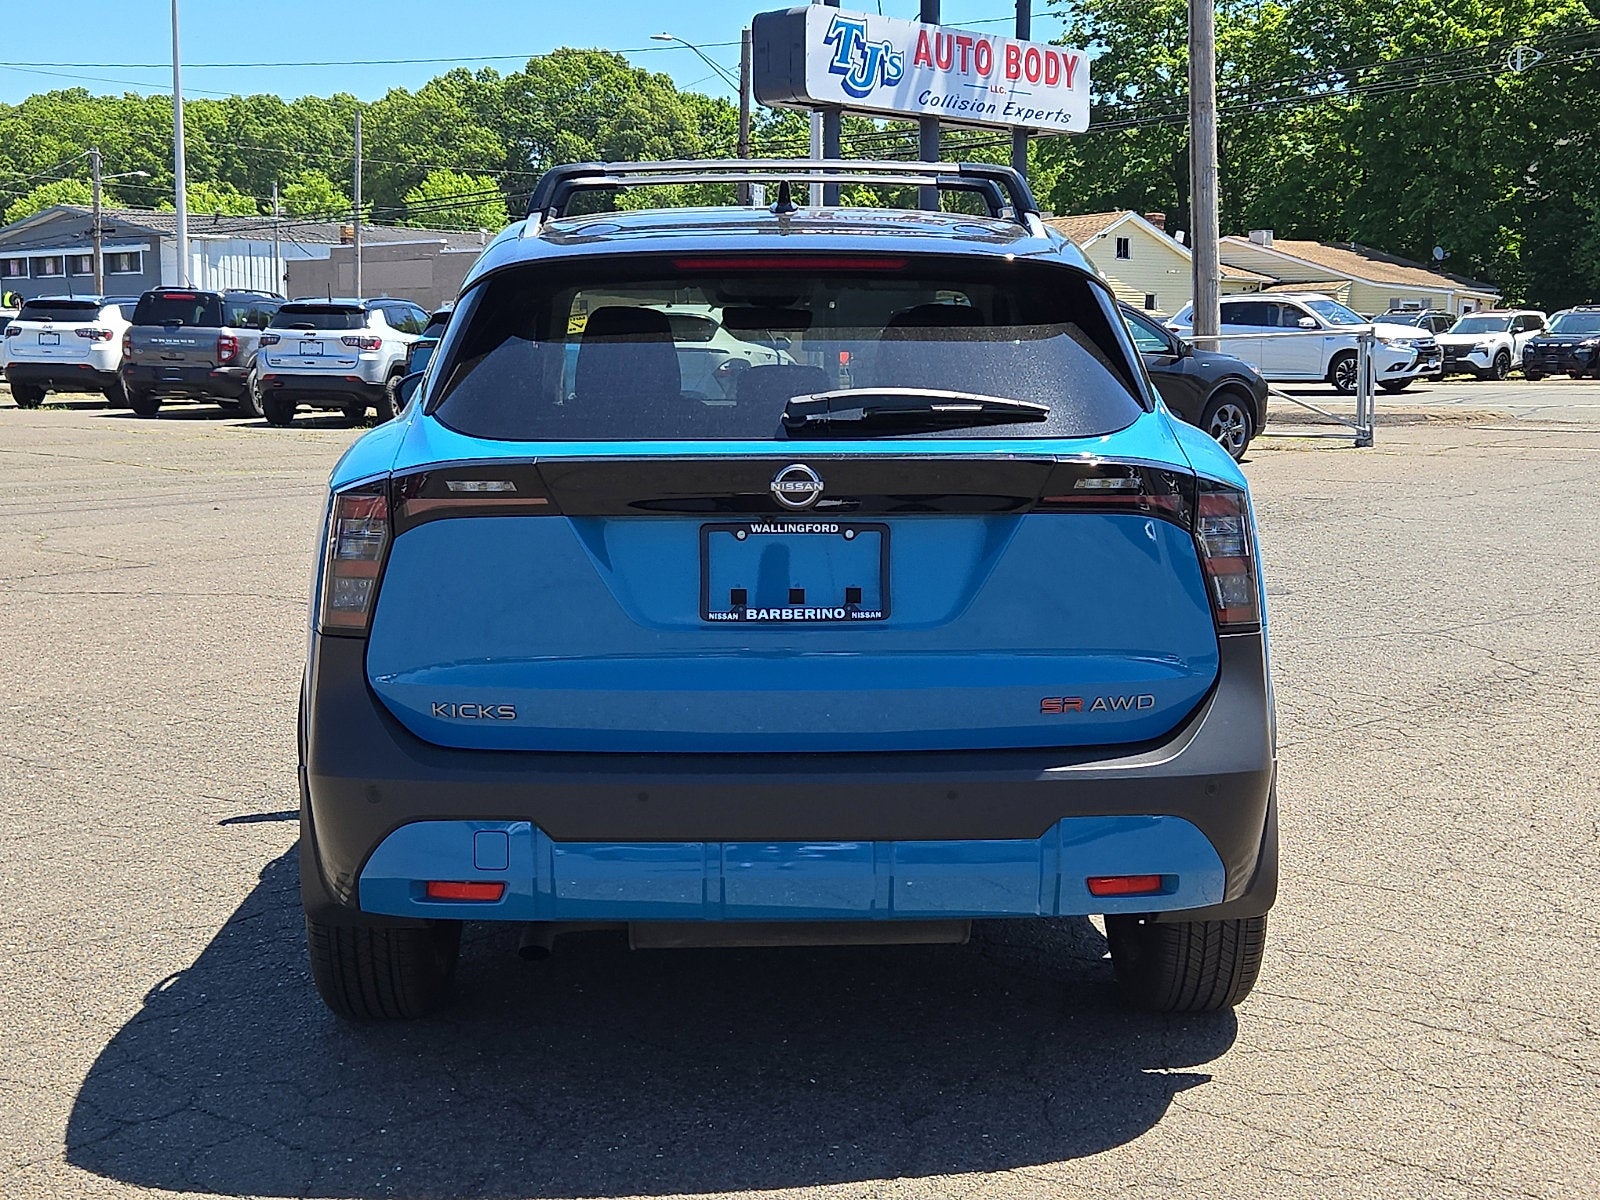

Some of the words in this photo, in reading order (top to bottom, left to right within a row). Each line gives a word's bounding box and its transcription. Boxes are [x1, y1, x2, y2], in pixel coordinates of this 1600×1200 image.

[823, 13, 904, 98] TJ's
[913, 29, 994, 79] AUTO
[1005, 44, 1081, 90] BODY
[918, 89, 997, 115] Collision
[1003, 101, 1072, 123] Experts
[771, 482, 824, 491] NISSAN
[750, 524, 839, 533] WALLINGFORD
[708, 612, 739, 620] NISSAN
[746, 608, 846, 620] BARBERINO
[852, 611, 881, 619] NISSAN
[431, 702, 516, 720] KICKS
[1041, 697, 1084, 714] SR
[1089, 694, 1155, 713] AWD
